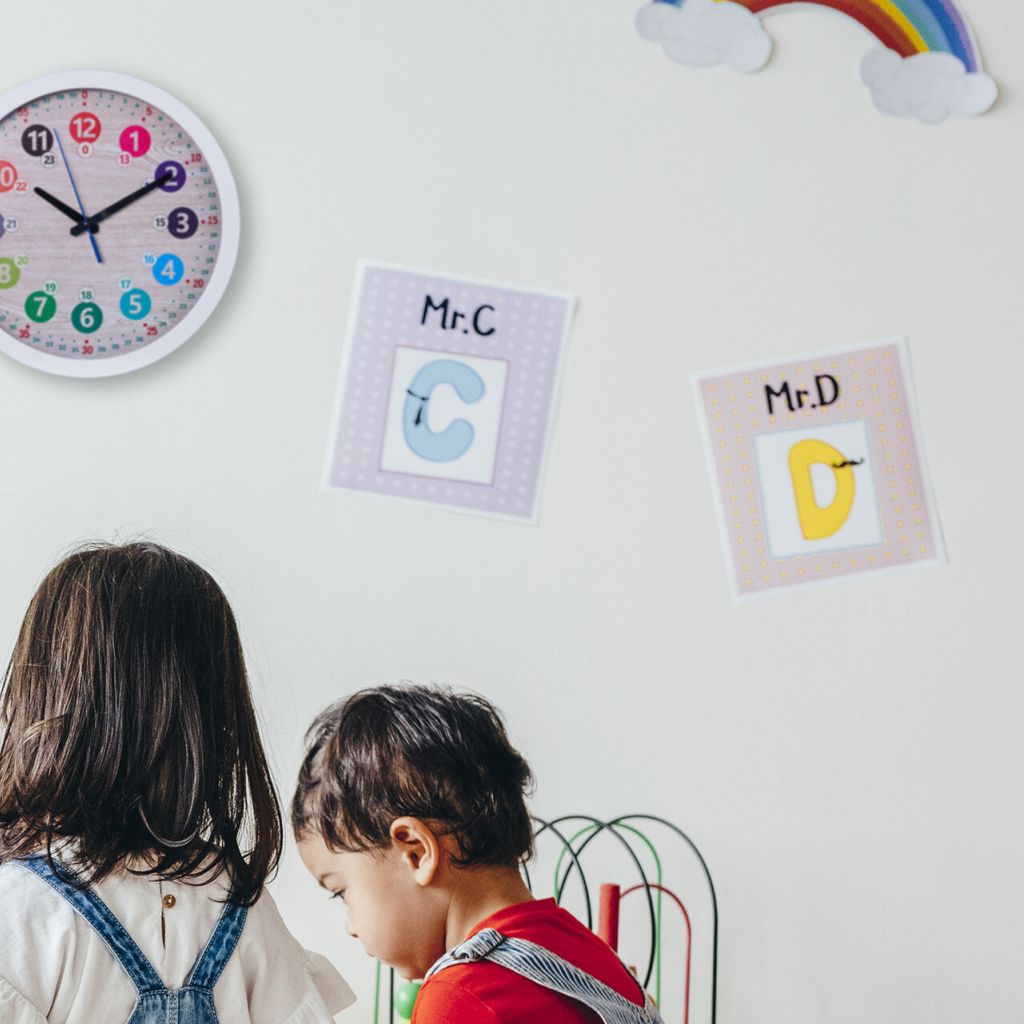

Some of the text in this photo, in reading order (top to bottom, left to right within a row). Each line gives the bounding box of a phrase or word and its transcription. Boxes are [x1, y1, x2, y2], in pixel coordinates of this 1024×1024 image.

[146, 107, 152, 116] 5
[73, 118, 96, 137] 12
[27, 130, 47, 151] 11
[130, 131, 139, 151] 1
[43, 155, 55, 165] 23
[120, 154, 130, 164] 13
[191, 153, 202, 162] 10
[164, 166, 178, 186] 2
[16, 182, 27, 191] 22
[6, 219, 17, 228] 21
[156, 218, 166, 226] 15
[176, 213, 190, 233] 3
[208, 216, 218, 225] 15
[161, 260, 176, 279] 4
[45, 283, 57, 292] 19
[120, 280, 131, 289] 17
[193, 279, 204, 288] 20
[81, 291, 92, 300] 18
[34, 297, 48, 316] 7
[129, 294, 142, 315] 5
[80, 308, 95, 327] 6
[420, 295, 496, 337] Mr.C
[19, 329, 30, 339] 35
[147, 326, 158, 335] 25
[82, 346, 93, 355] 30
[764, 374, 839, 416] Mr.D
[402, 358, 486, 464] C
[787, 437, 857, 542] D
